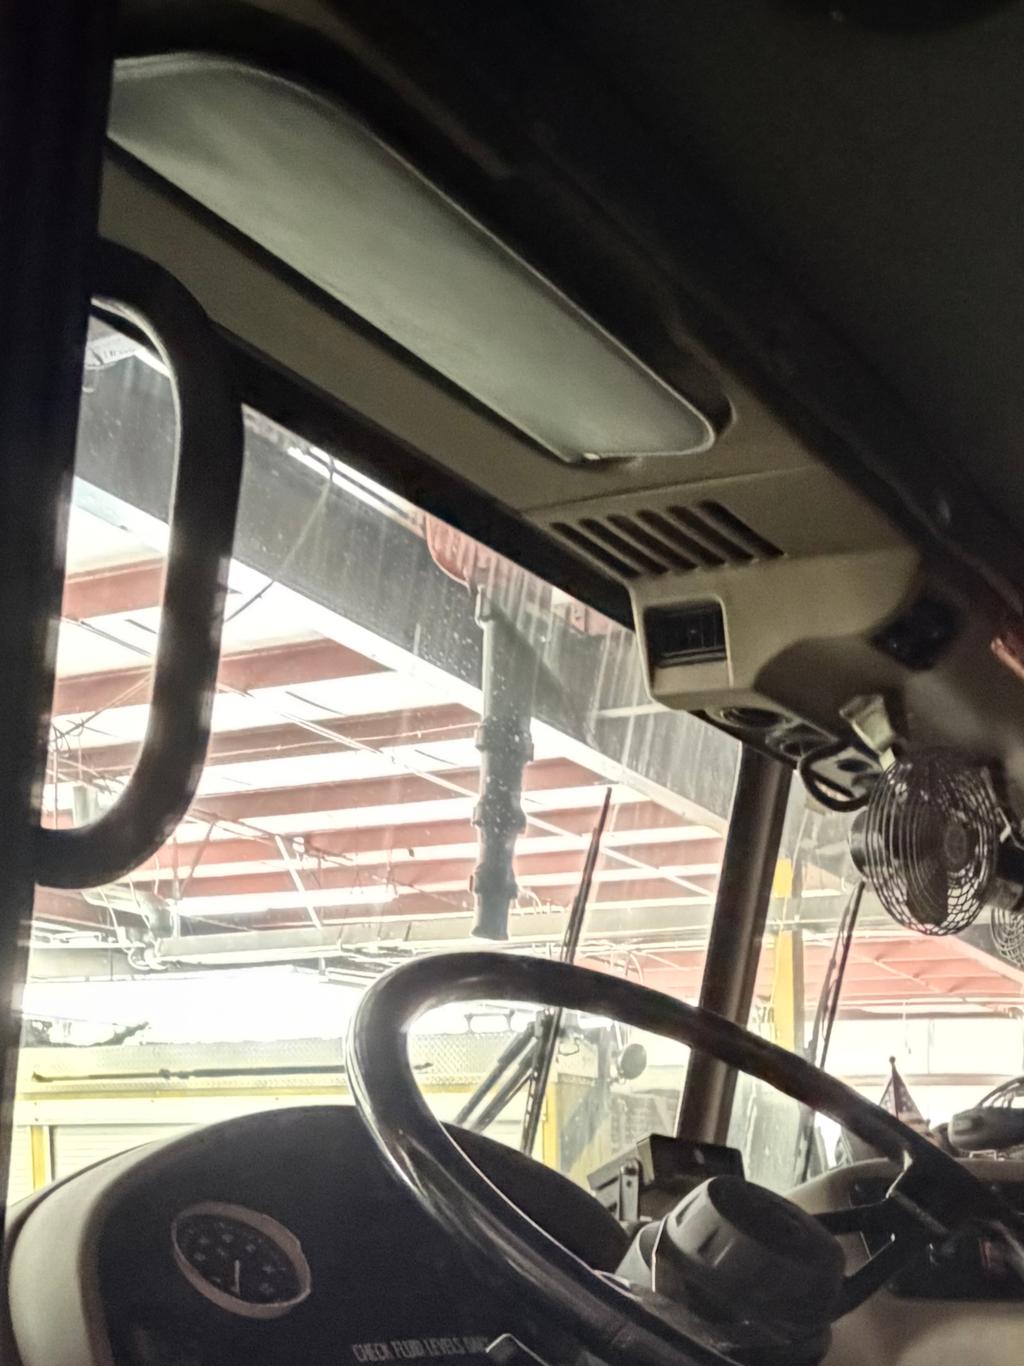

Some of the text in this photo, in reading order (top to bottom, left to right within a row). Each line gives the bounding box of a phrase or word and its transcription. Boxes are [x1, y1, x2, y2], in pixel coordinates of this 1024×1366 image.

[352, 1342, 396, 1363] CHECK
[389, 1339, 426, 1359] FLUID
[423, 1336, 467, 1356] LEVELS
